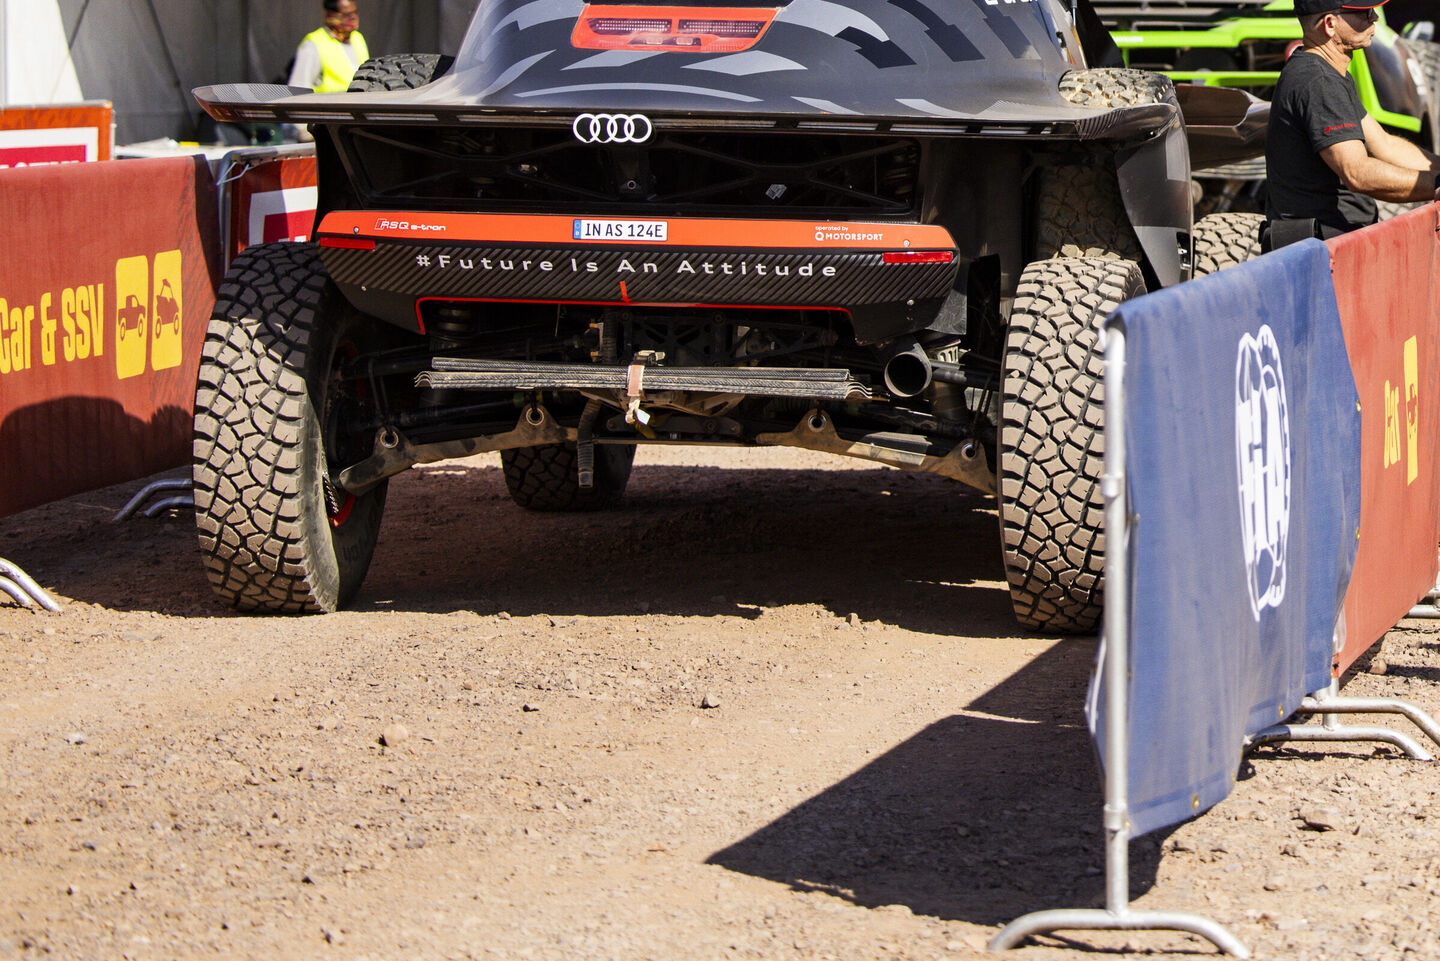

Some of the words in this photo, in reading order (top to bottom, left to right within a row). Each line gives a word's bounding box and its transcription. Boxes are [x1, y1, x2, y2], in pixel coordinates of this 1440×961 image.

[380, 220, 409, 230] RSQ
[410, 223, 446, 231] e-tron
[585, 223, 601, 236] IN
[605, 223, 623, 237] AS
[627, 224, 663, 238] 124E
[825, 233, 884, 241] MOTORSPORT
[415, 254, 554, 271] #Future
[571, 258, 598, 272] Is
[617, 259, 658, 273] An
[676, 259, 837, 277] Attitude
[0, 296, 35, 375] Car
[40, 291, 57, 366] &
[61, 282, 104, 362] SSV
